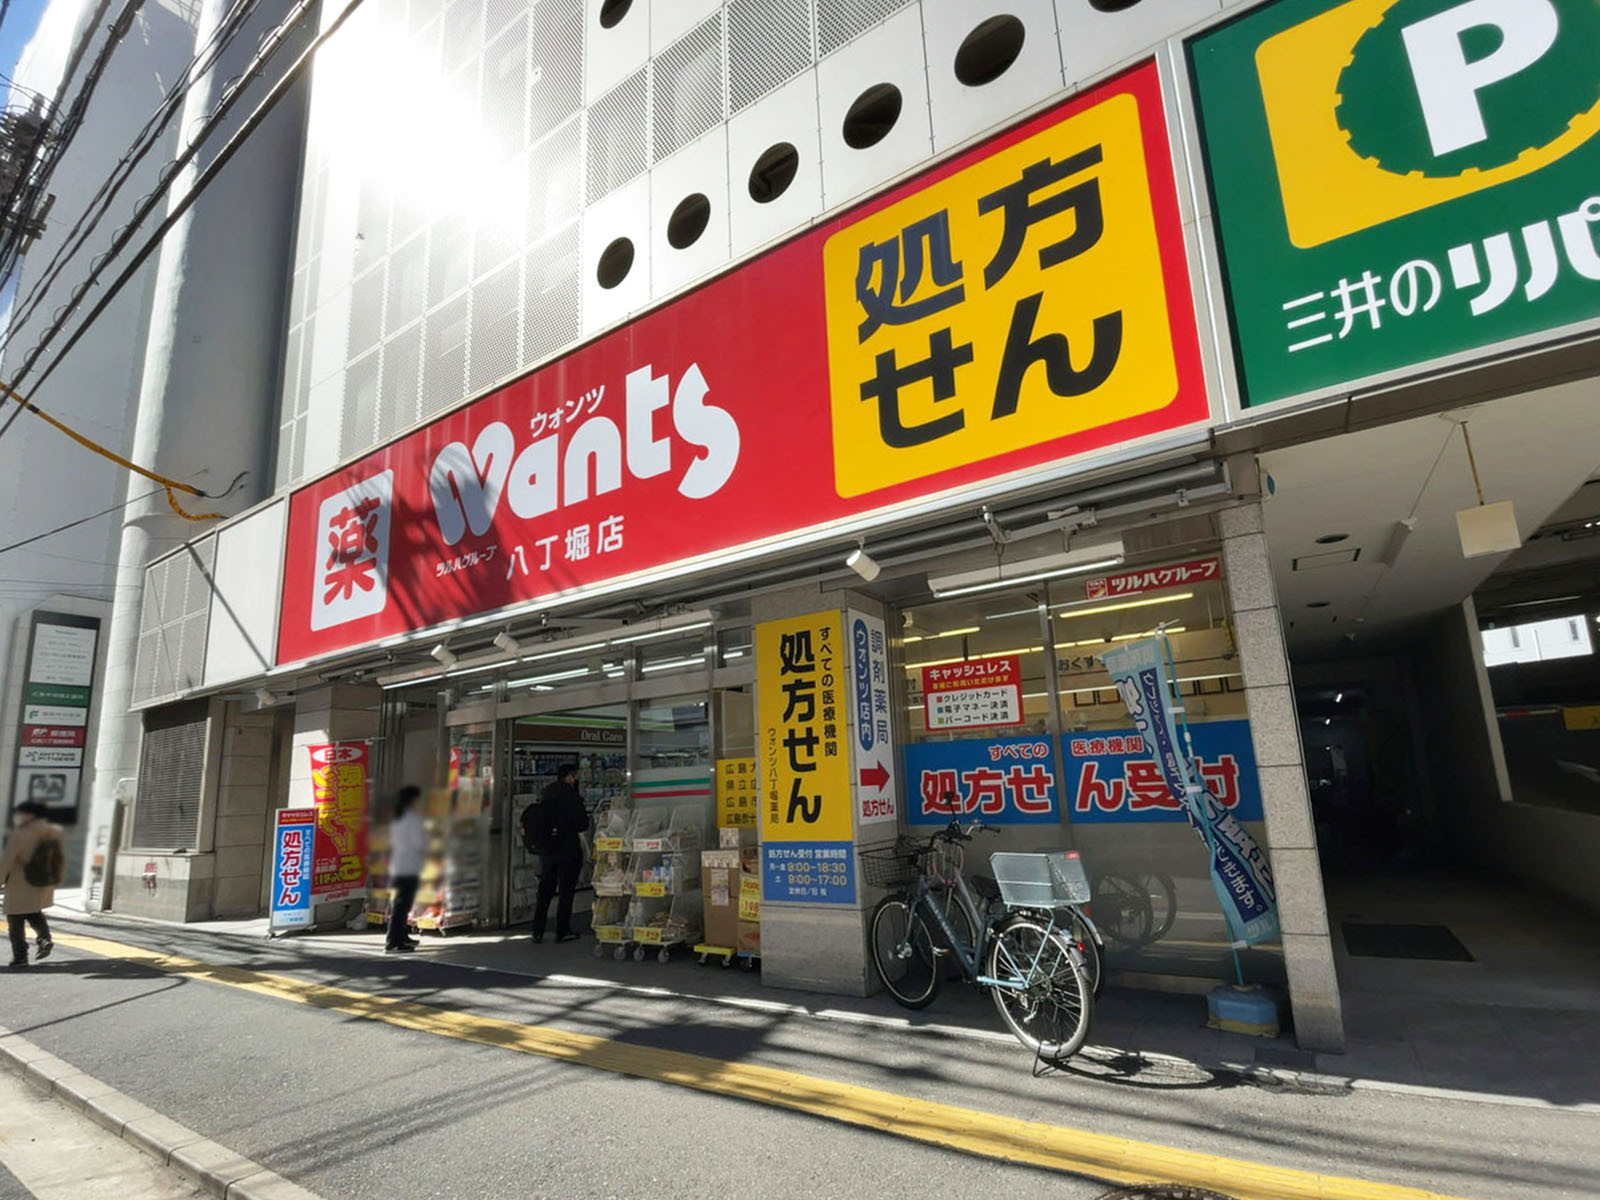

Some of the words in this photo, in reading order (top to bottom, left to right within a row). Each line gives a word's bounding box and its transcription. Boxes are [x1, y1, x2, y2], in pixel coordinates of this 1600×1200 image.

[1401, 0, 1559, 157] P
[855, 143, 1104, 345] 処方
[1282, 196, 1600, 352] 三井のリパ
[859, 291, 1123, 449] せん
[530, 385, 606, 438] ウォンツ
[429, 362, 741, 546] Wants
[323, 496, 380, 606] 薬
[435, 545, 497, 577] ツルハグループ
[506, 515, 624, 581] 八丁堀店
[1111, 561, 1217, 592] ツルハグループ
[819, 626, 837, 756] すべての医療機関
[870, 628, 888, 744] 調剤薬局
[929, 660, 1012, 681] キャッシュレス
[943, 688, 1008, 703] クレジットカード
[779, 630, 822, 823] 処方せん
[944, 699, 1009, 714] 電子マネー決済
[945, 711, 1009, 725] バーコード決済
[988, 742, 1048, 760] すべての
[1070, 736, 1143, 756] 医療機関
[862, 798, 895, 817] 処方せん
[921, 766, 1053, 814] 処方せ
[279, 831, 302, 906] 処方せん
